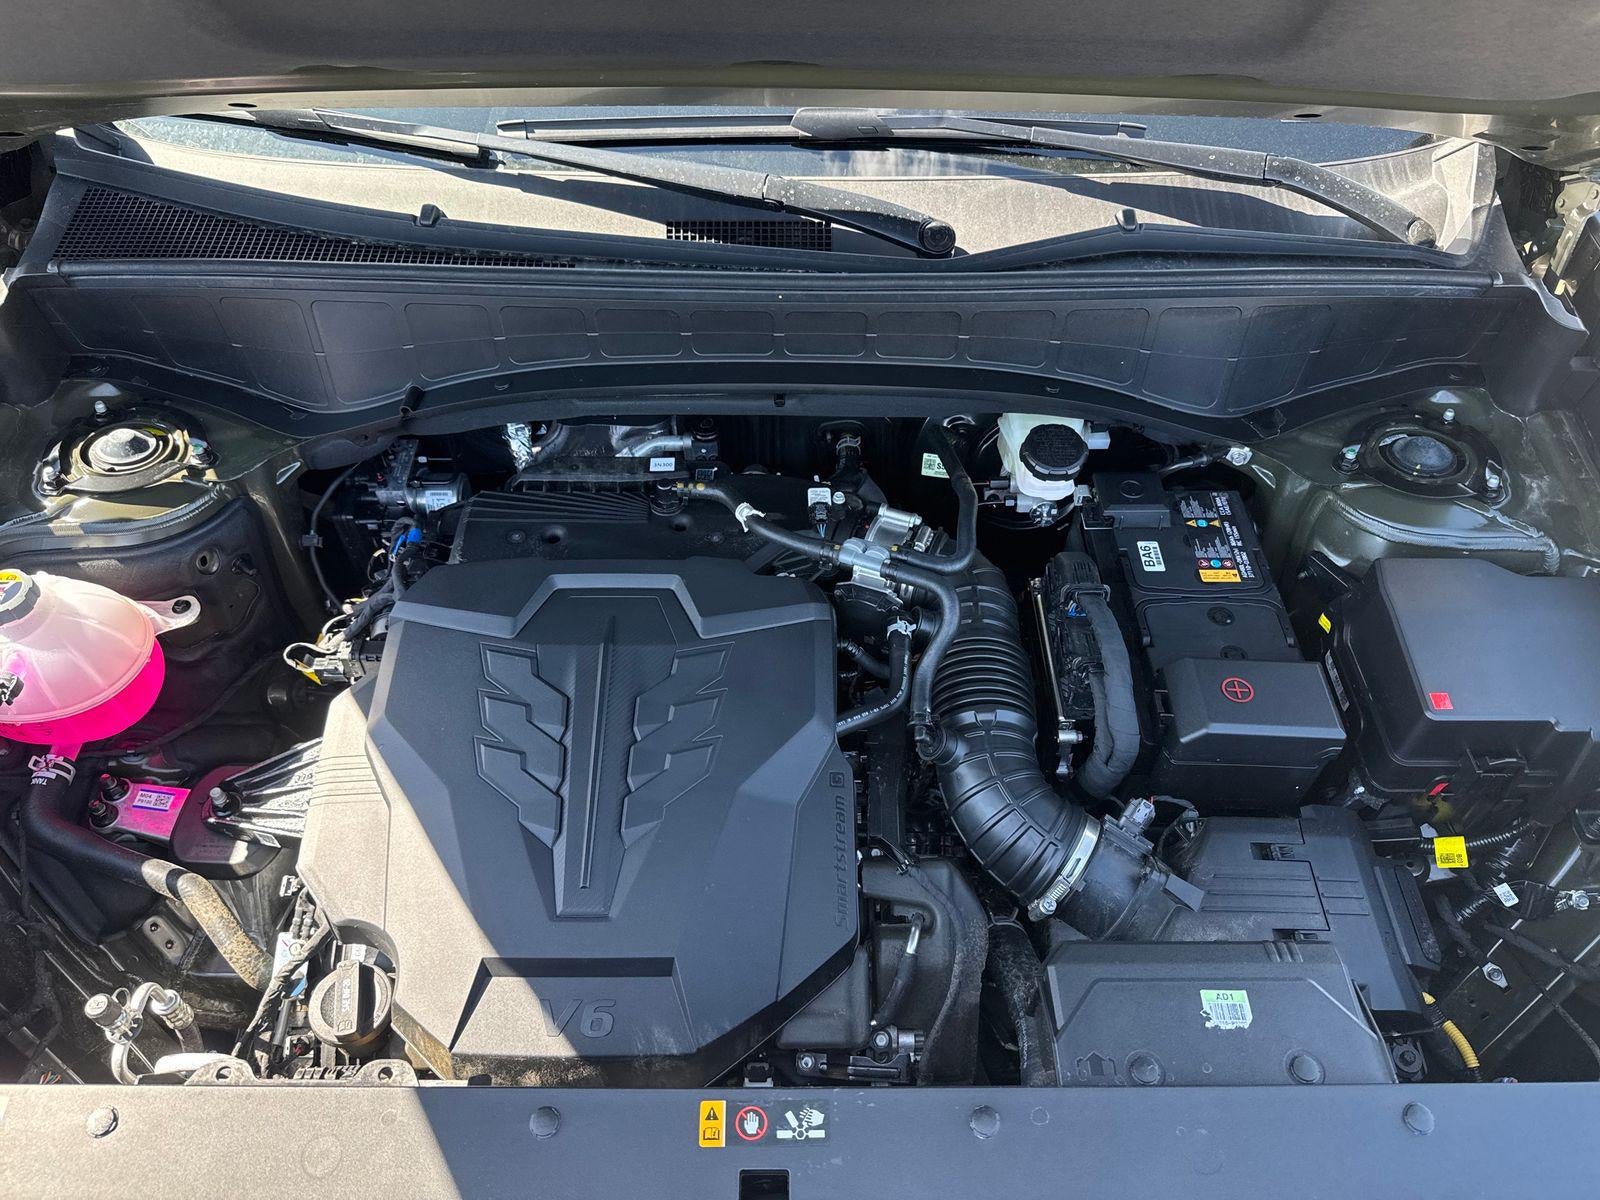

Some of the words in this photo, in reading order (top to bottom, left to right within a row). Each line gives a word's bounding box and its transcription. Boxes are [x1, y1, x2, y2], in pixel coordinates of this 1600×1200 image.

[1140, 545, 1156, 567] BA6
[833, 795, 849, 930] Smartstream
[1216, 993, 1234, 1001] AD1
[539, 999, 617, 1038] V6
